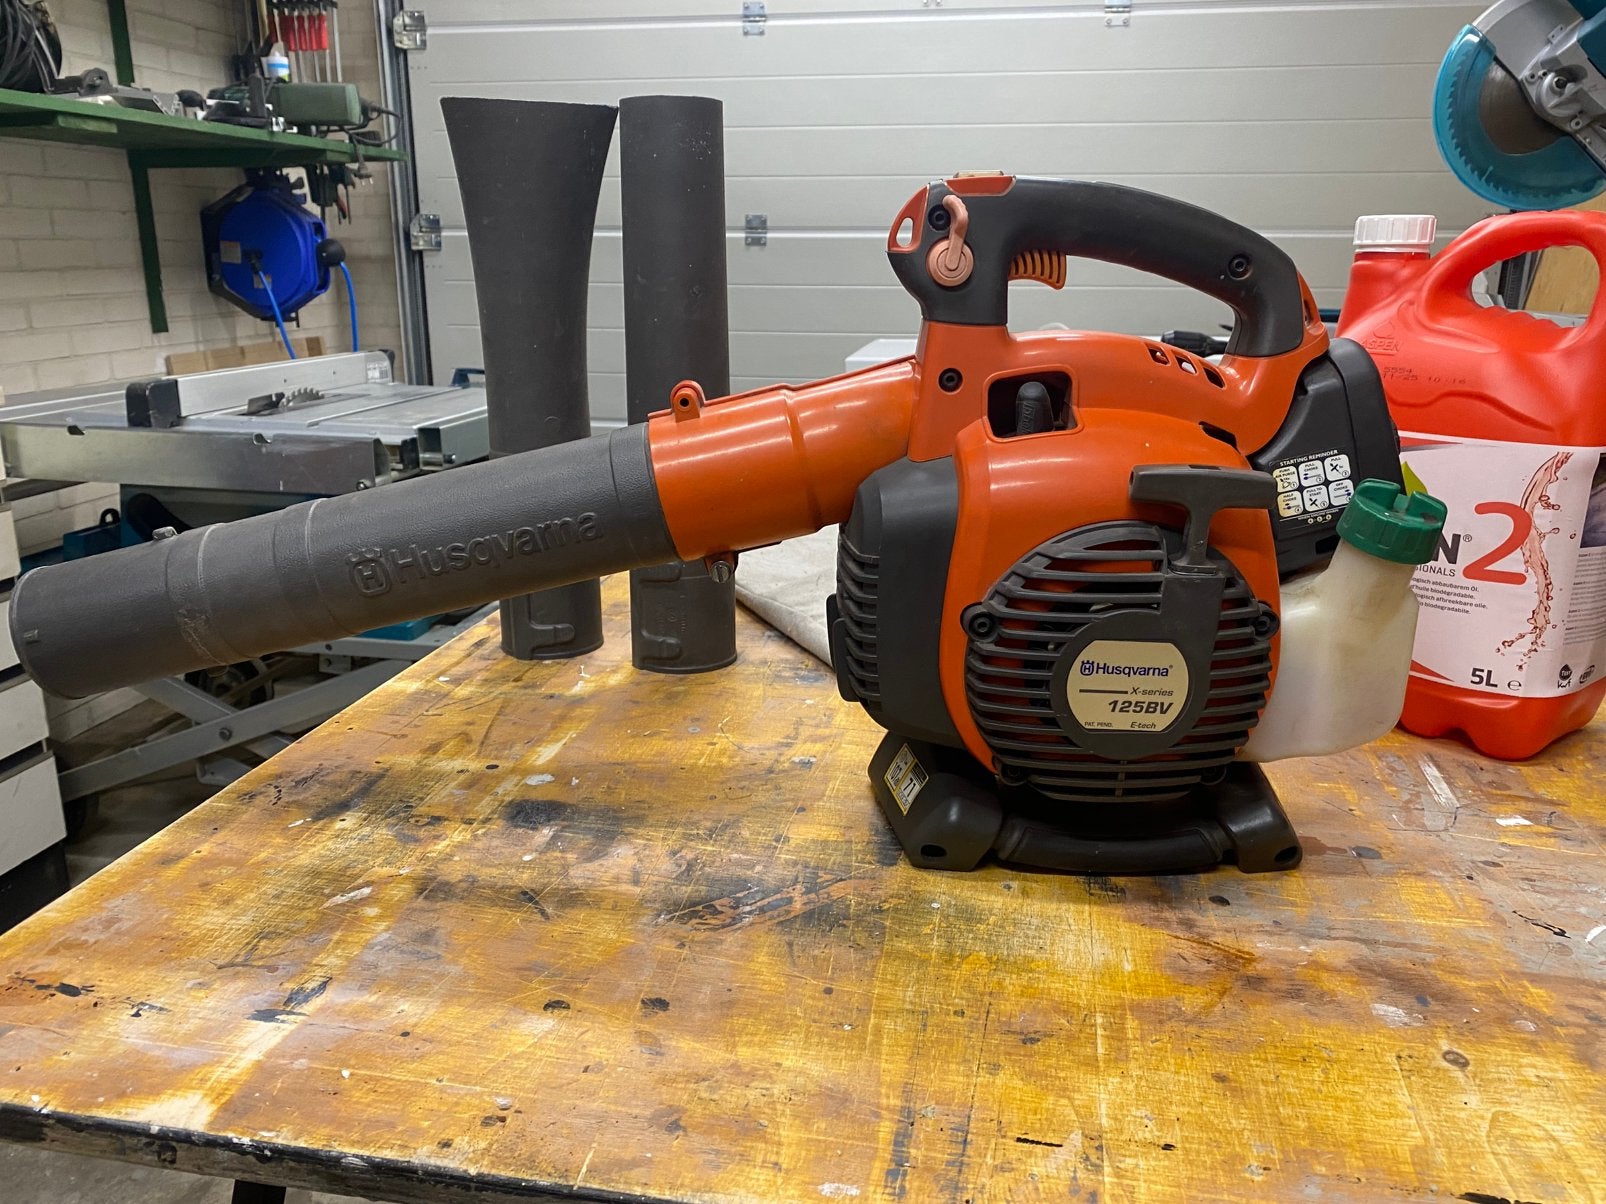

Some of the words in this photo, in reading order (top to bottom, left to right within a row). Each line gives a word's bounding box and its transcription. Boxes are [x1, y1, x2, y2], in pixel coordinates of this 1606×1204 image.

[1361, 339, 1402, 352] ASPEN
[1280, 456, 1308, 466] STARTING
[1309, 449, 1338, 460] REMINDER
[388, 510, 603, 584] Husqvarna
[1463, 501, 1533, 585] 2
[1411, 577, 1431, 585] ogisch
[1431, 580, 1470, 591] abbaubarem
[1415, 593, 1435, 601] ogisch
[1435, 597, 1473, 607] afbreekbare
[1096, 662, 1169, 677] Husqvarna
[1470, 667, 1498, 688] 5L
[1130, 687, 1174, 697] X-series
[1108, 700, 1174, 714] 125BV
[1130, 721, 1157, 729] E-tech
